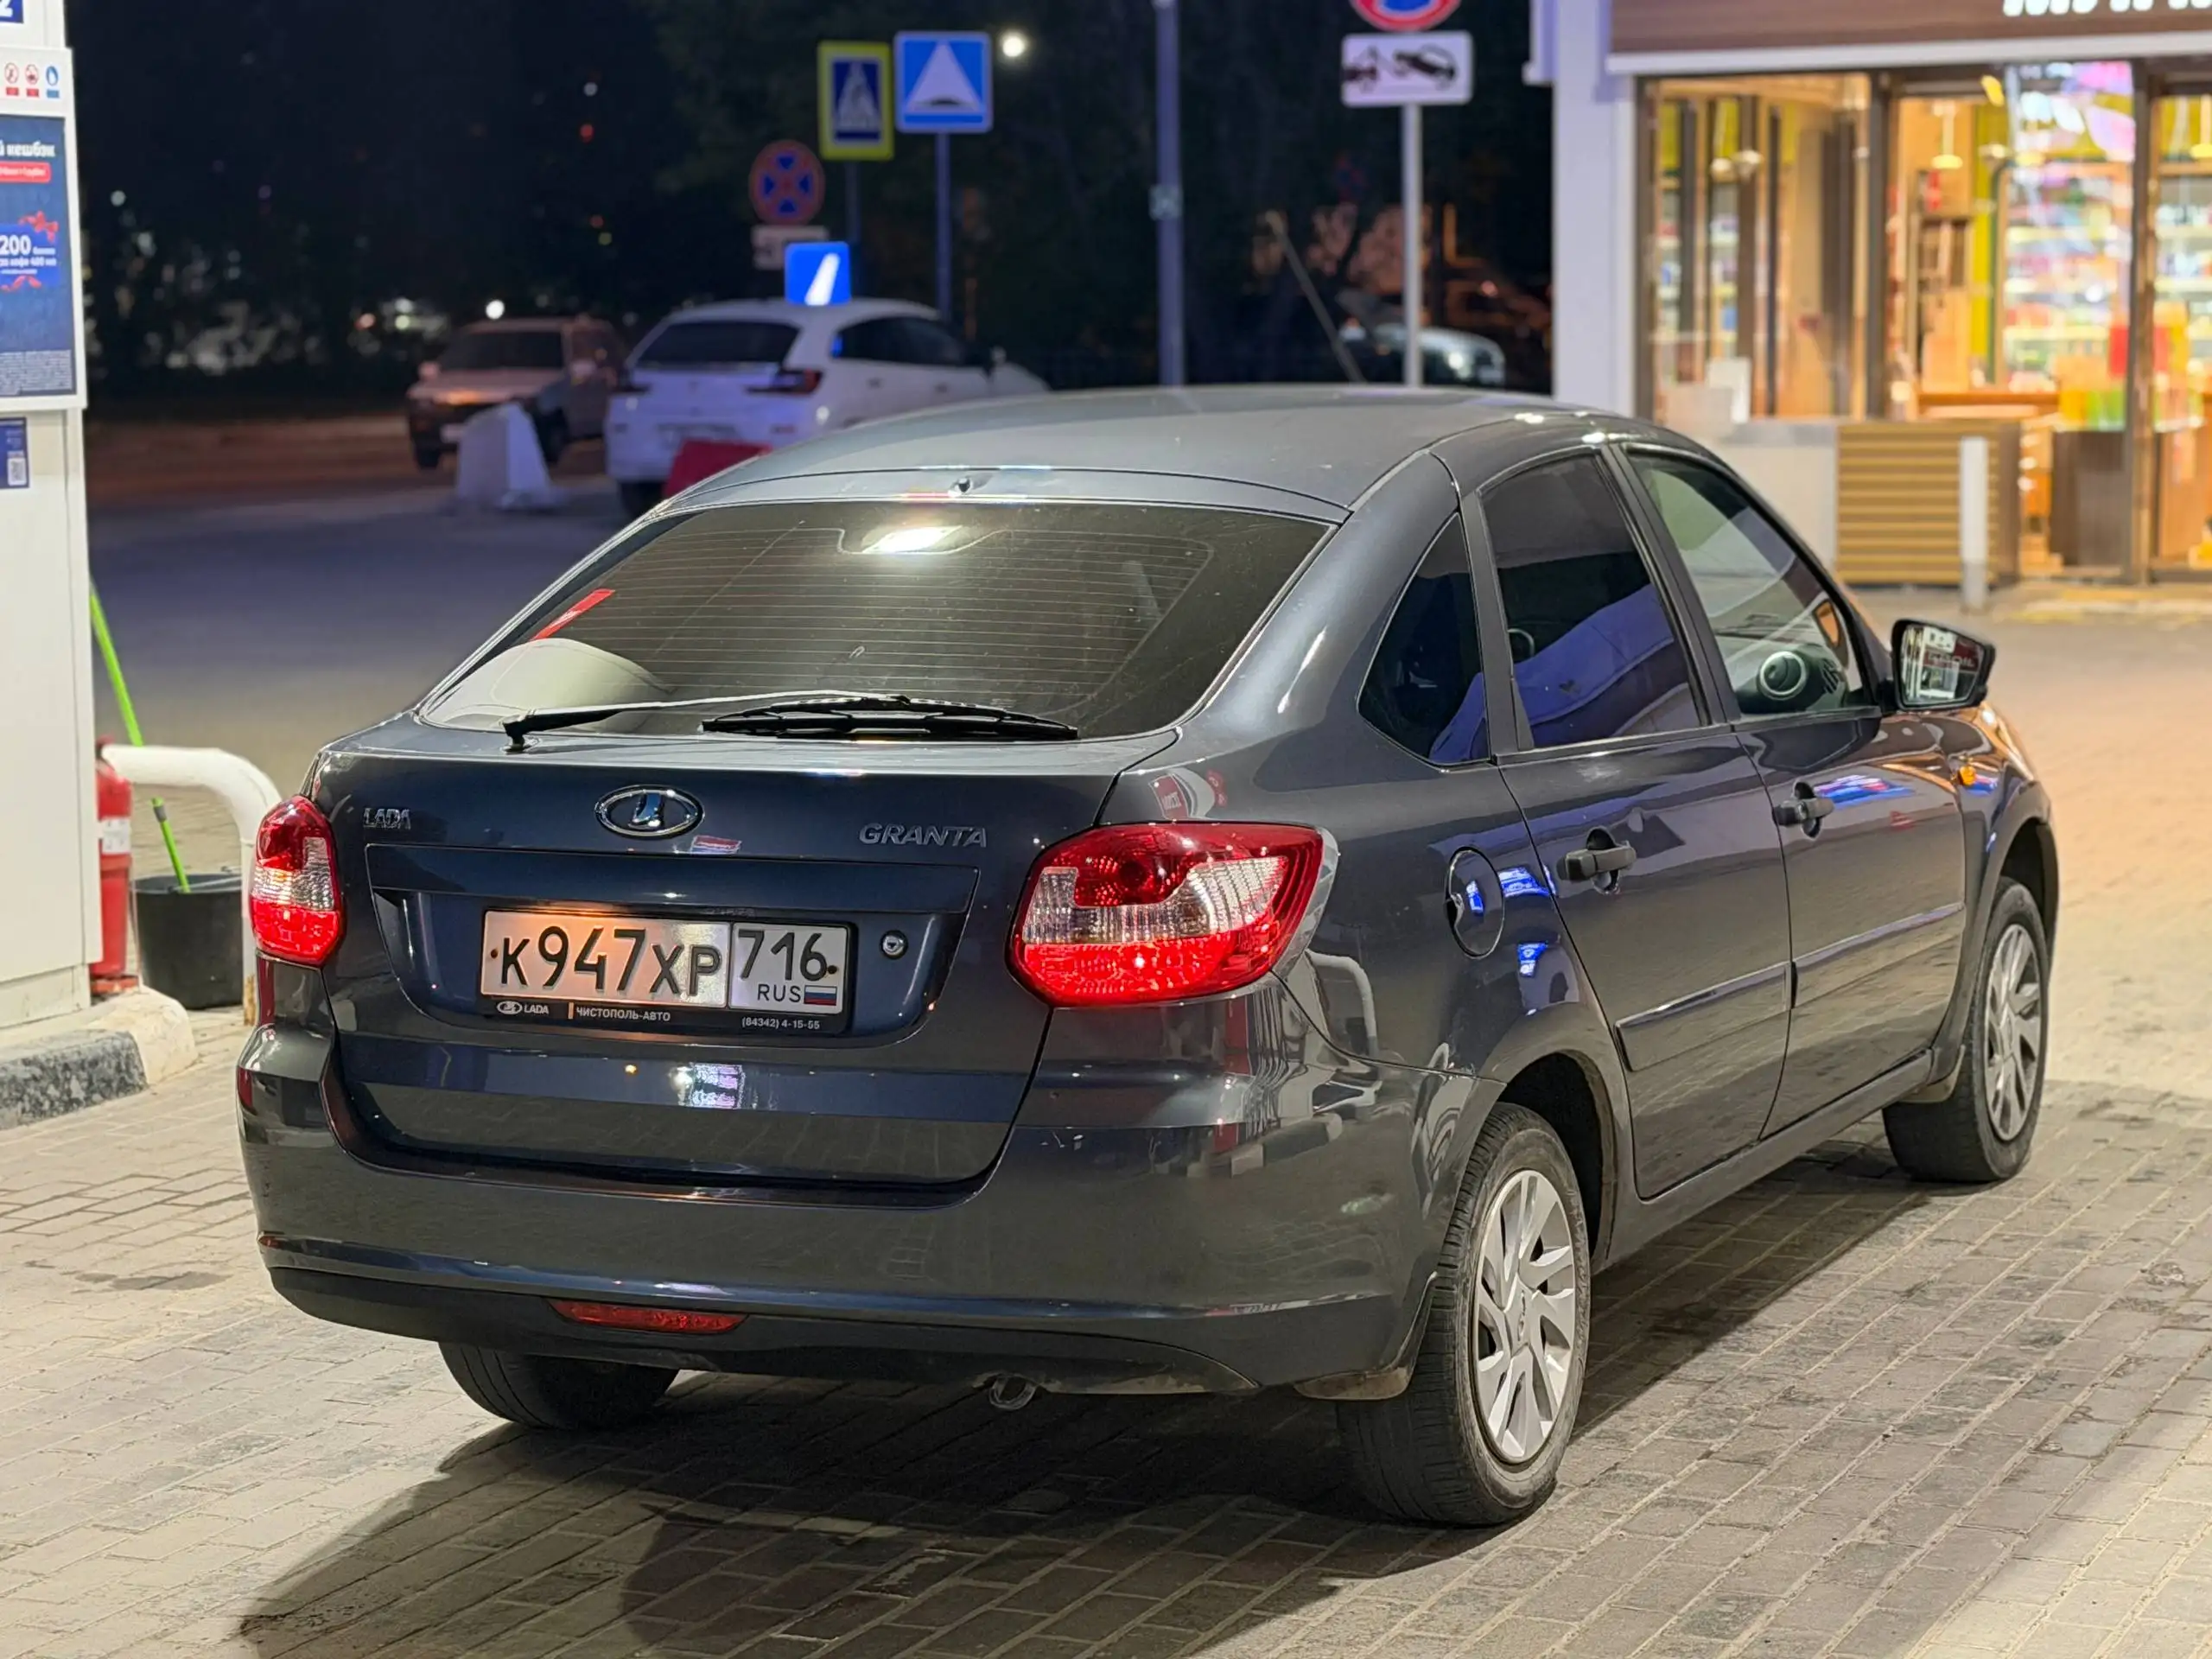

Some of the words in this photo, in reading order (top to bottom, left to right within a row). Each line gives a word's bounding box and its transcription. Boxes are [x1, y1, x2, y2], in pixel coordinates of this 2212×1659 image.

[363, 807, 411, 830] LADA
[859, 823, 987, 849] GRANTA
[500, 925, 722, 997] К947ХР
[738, 928, 828, 982] 716
[757, 983, 801, 1002] RUS
[524, 1002, 550, 1014] LADA
[575, 1005, 671, 1021] ЧИСТОПОЛЬ-АВТО
[742, 1017, 779, 1030] (84342)
